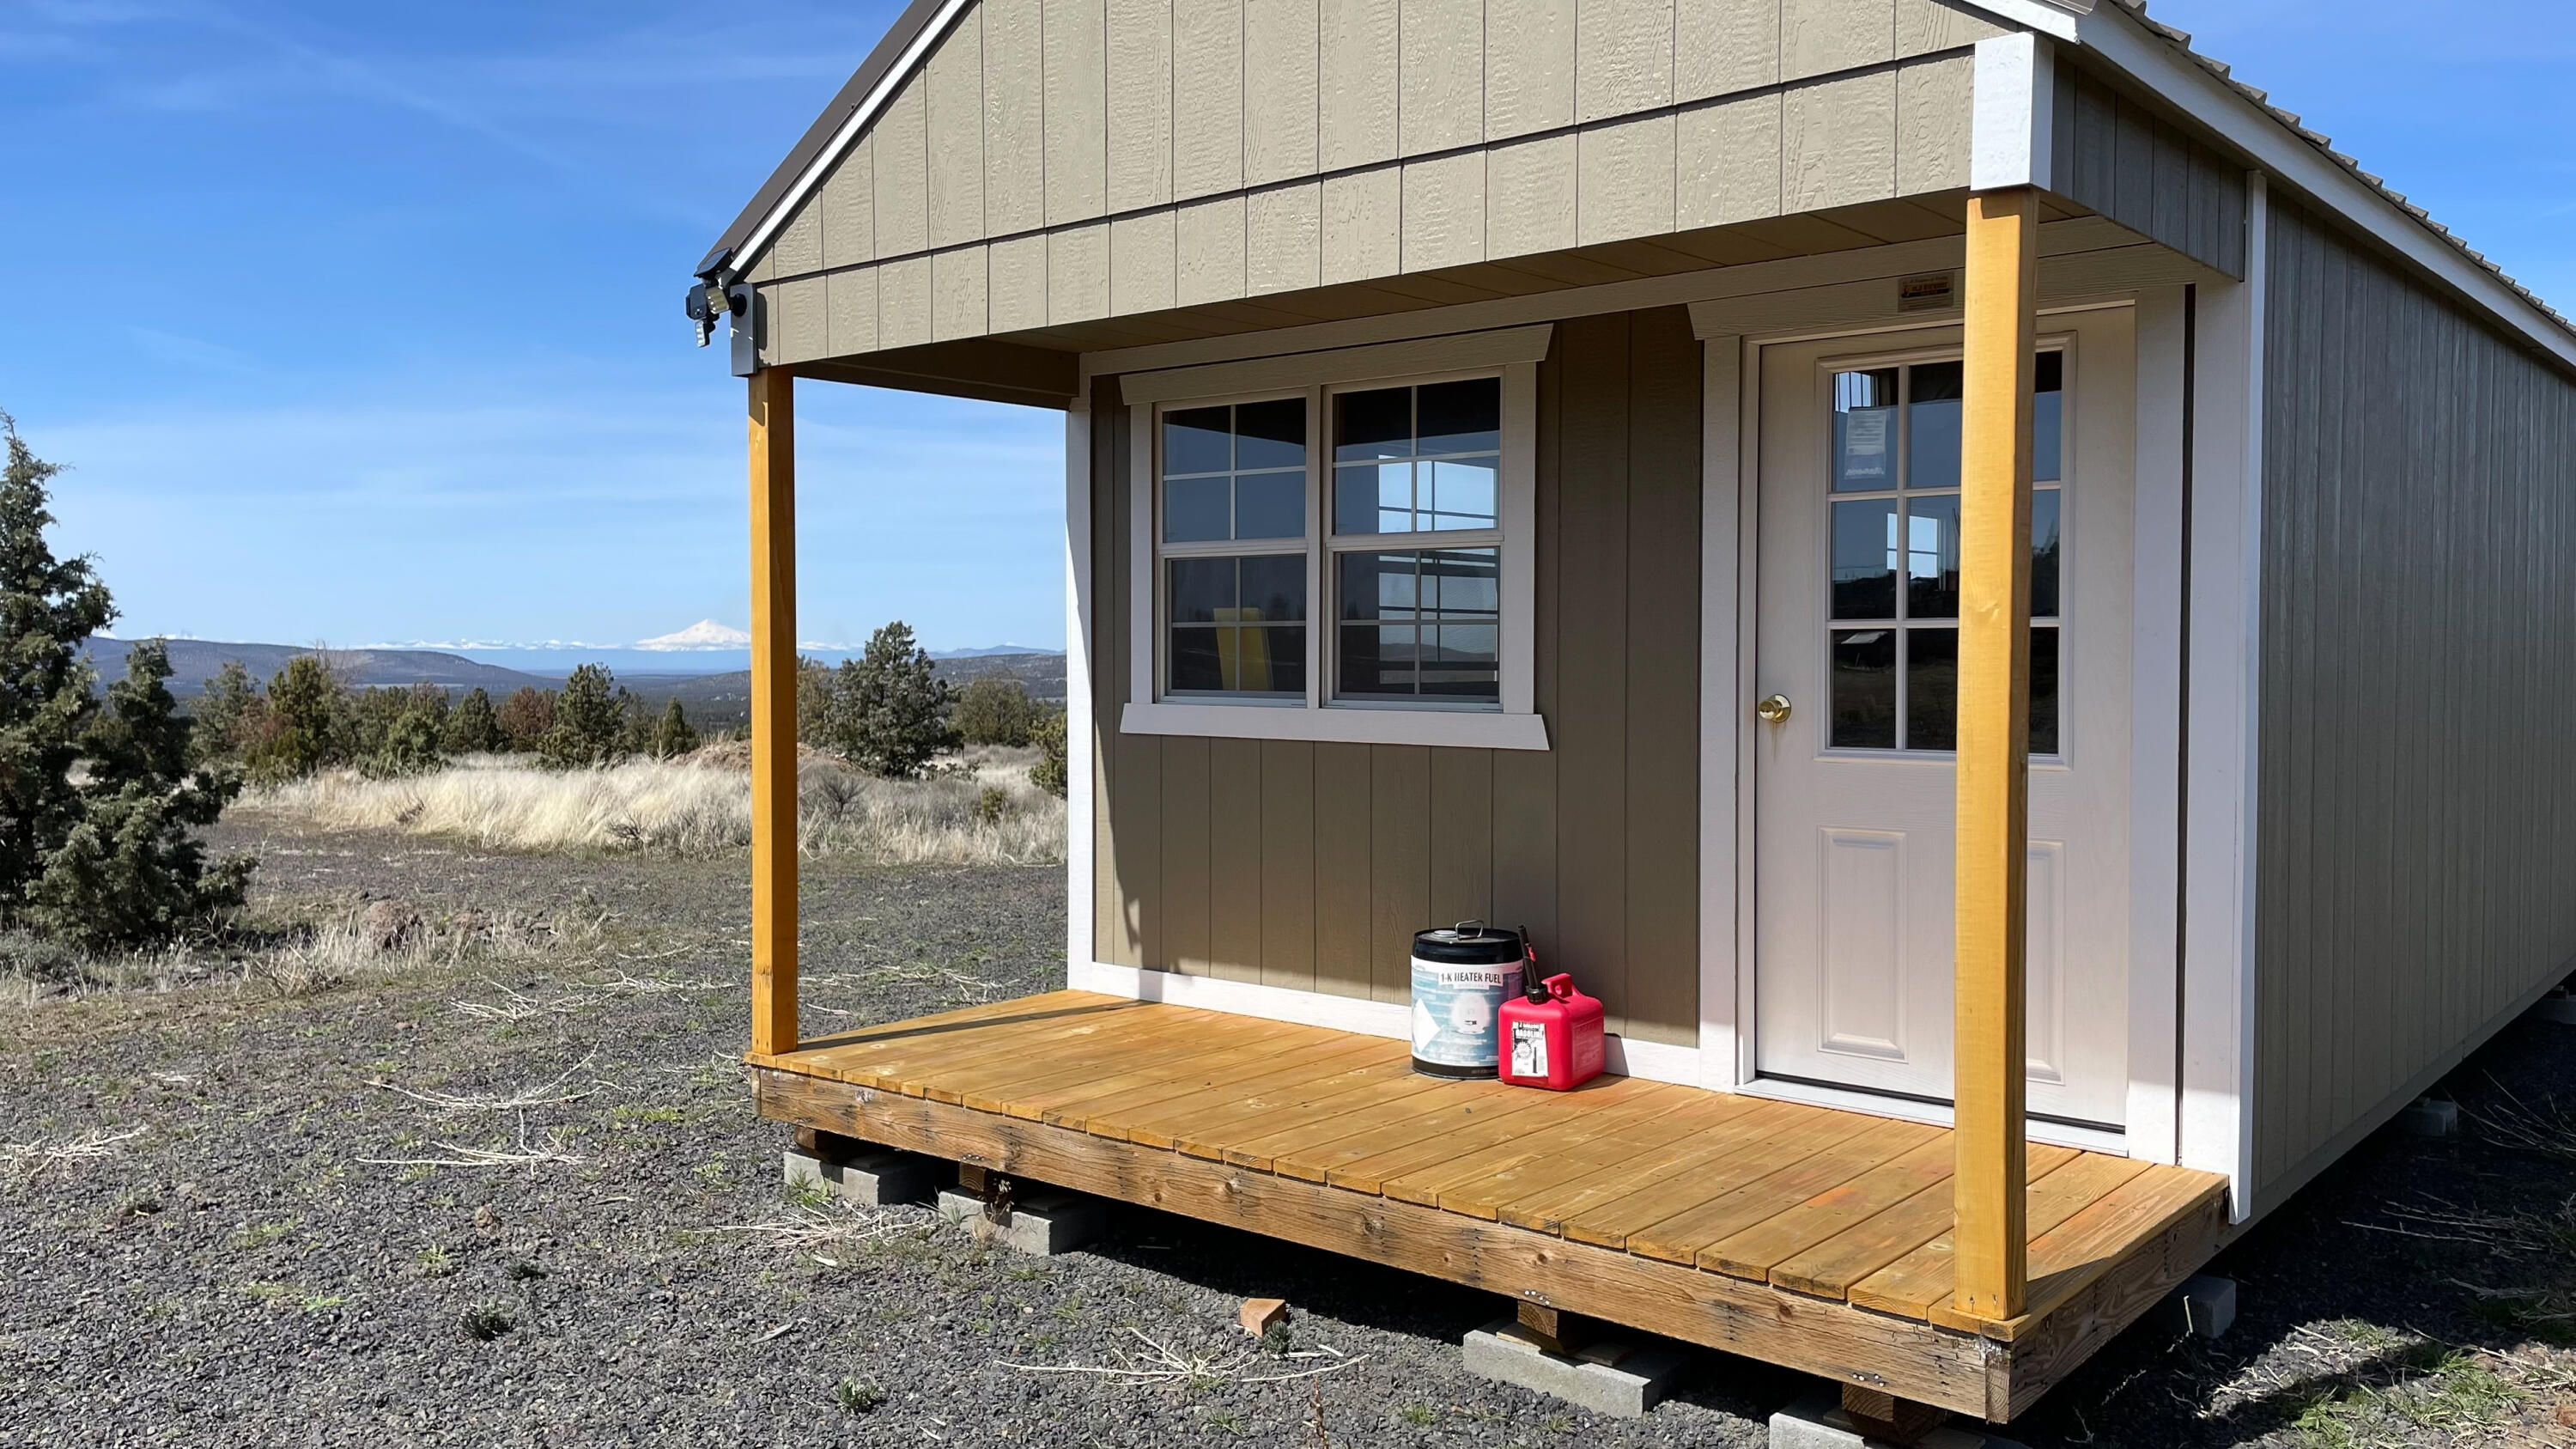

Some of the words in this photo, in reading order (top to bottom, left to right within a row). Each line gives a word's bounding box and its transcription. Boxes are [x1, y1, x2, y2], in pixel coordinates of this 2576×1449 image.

[1442, 972, 1452, 983] 1-K
[1455, 972, 1483, 982] HEATER
[1485, 973, 1501, 983] FUEL
